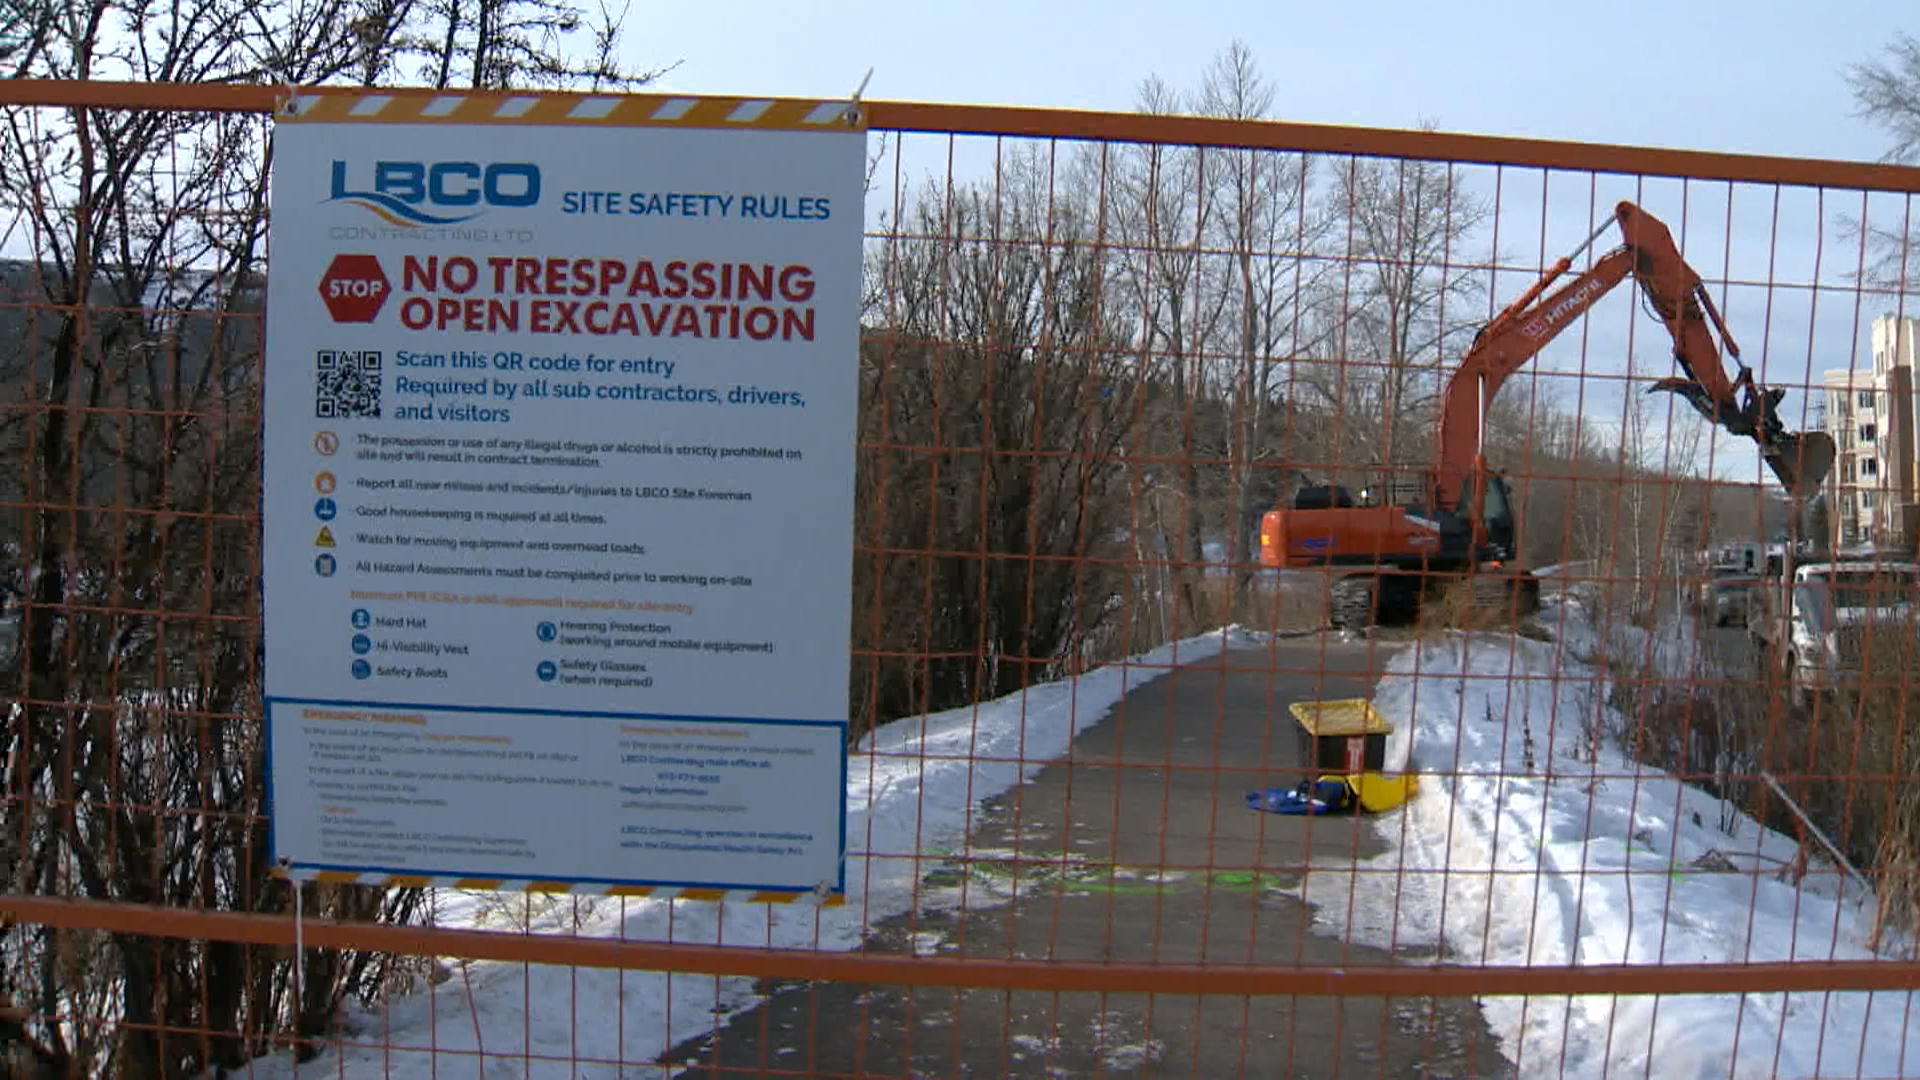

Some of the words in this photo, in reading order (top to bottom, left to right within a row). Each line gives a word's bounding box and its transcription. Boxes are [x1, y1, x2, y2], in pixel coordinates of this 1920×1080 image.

[331, 159, 541, 207] LBCO
[562, 191, 622, 214] SITE
[628, 193, 734, 217] SAFETY
[741, 195, 831, 220] RULES
[328, 226, 489, 242] CONTRACTING
[491, 229, 534, 243] LTD
[403, 255, 479, 295] NO
[487, 256, 816, 302] TRESPASSING
[329, 279, 383, 298] STOP
[400, 297, 520, 335] OPEN
[530, 299, 815, 342] EXCAVATION
[396, 351, 445, 369] Scan
[451, 351, 488, 369] this
[493, 352, 524, 371] QR
[528, 353, 581, 372] code
[586, 354, 615, 373] for
[619, 357, 676, 379] entry
[396, 376, 487, 397] Required
[493, 378, 518, 400] by
[522, 379, 549, 398] all
[552, 381, 591, 399] sub
[596, 383, 722, 405] contractors,
[727, 385, 806, 408] drivers,
[394, 402, 434, 421] and
[437, 404, 511, 423] visitors
[357, 434, 378, 445] The
[381, 436, 446, 448] possession
[448, 438, 459, 448] or
[462, 439, 483, 449] use
[486, 437, 498, 449] of
[500, 440, 521, 452] any
[524, 438, 561, 452] illegal
[564, 440, 599, 454] drugs
[601, 443, 613, 452] or
[616, 442, 661, 454] alcohol
[663, 444, 674, 455] is
[675, 445, 718, 459] strictly
[720, 446, 783, 460] prohibited
[786, 449, 802, 460] on
[379, 451, 402, 462] and
[404, 451, 425, 462] will
[427, 452, 462, 463] result
[464, 452, 476, 463] in
[478, 453, 528, 465] contract
[356, 477, 397, 491] Report
[398, 478, 414, 489] all
[415, 480, 441, 490] near
[486, 481, 508, 492] and
[620, 486, 632, 497] to
[635, 487, 669, 498] LBCO
[673, 487, 695, 498] Site
[698, 488, 752, 500] Foreman
[356, 506, 387, 517] Good
[389, 506, 471, 522] housekeeping
[474, 509, 484, 520] is
[486, 510, 536, 523] required
[539, 512, 551, 522] at
[552, 512, 569, 523] all
[356, 533, 393, 545] Watch
[396, 534, 411, 545] for
[414, 536, 457, 550] moving
[459, 537, 524, 551] equipment
[526, 539, 549, 550] and
[551, 540, 608, 552] overhead
[355, 560, 371, 573] All
[373, 561, 414, 573] Hazard
[416, 562, 493, 577] Assessments
[495, 566, 525, 578] must
[527, 567, 542, 578] be
[545, 569, 610, 582] completed
[613, 572, 641, 584] prior
[644, 572, 657, 583] to
[659, 573, 707, 587] working
[709, 575, 752, 587] on-site
[375, 617, 405, 628] Hard
[406, 617, 427, 629] Hat
[560, 621, 607, 633] Hearing
[609, 622, 671, 635] Protection
[442, 643, 469, 656] Vest
[614, 637, 659, 648] around
[659, 638, 700, 650] mobile
[376, 666, 412, 680] Safety
[414, 667, 448, 679] Boots
[559, 659, 598, 672] Safety
